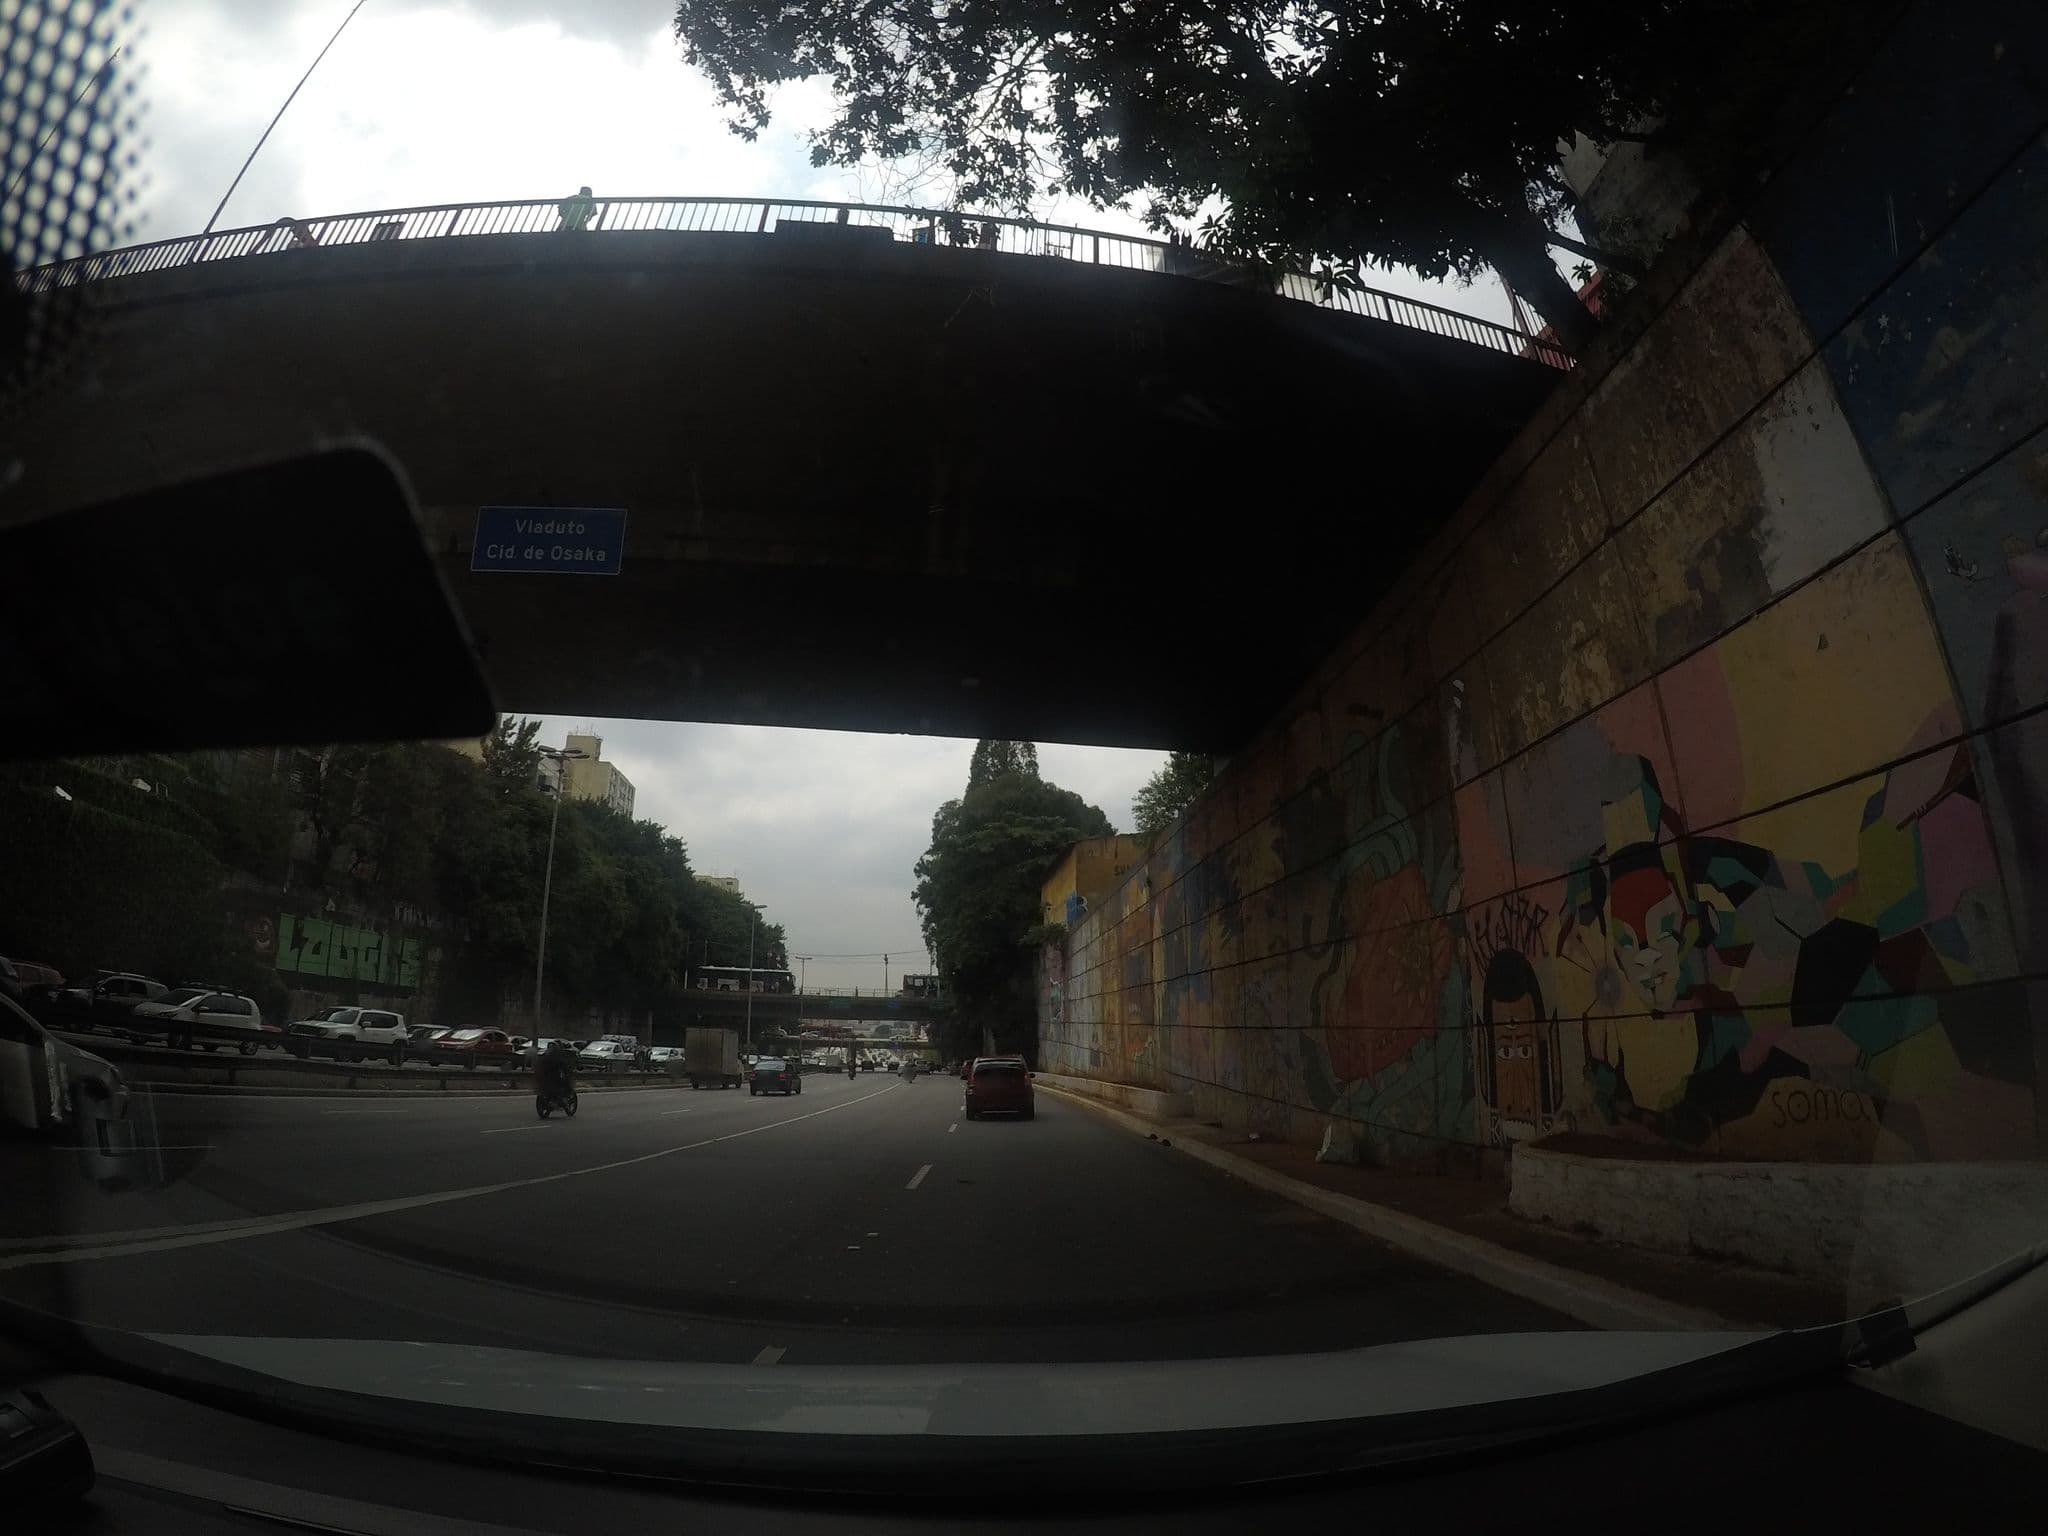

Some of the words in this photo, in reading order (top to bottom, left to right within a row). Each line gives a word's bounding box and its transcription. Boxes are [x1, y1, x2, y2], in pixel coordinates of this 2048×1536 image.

[515, 519, 585, 534] Viaduto
[524, 545, 545, 560] de
[550, 545, 606, 561] Osaka
